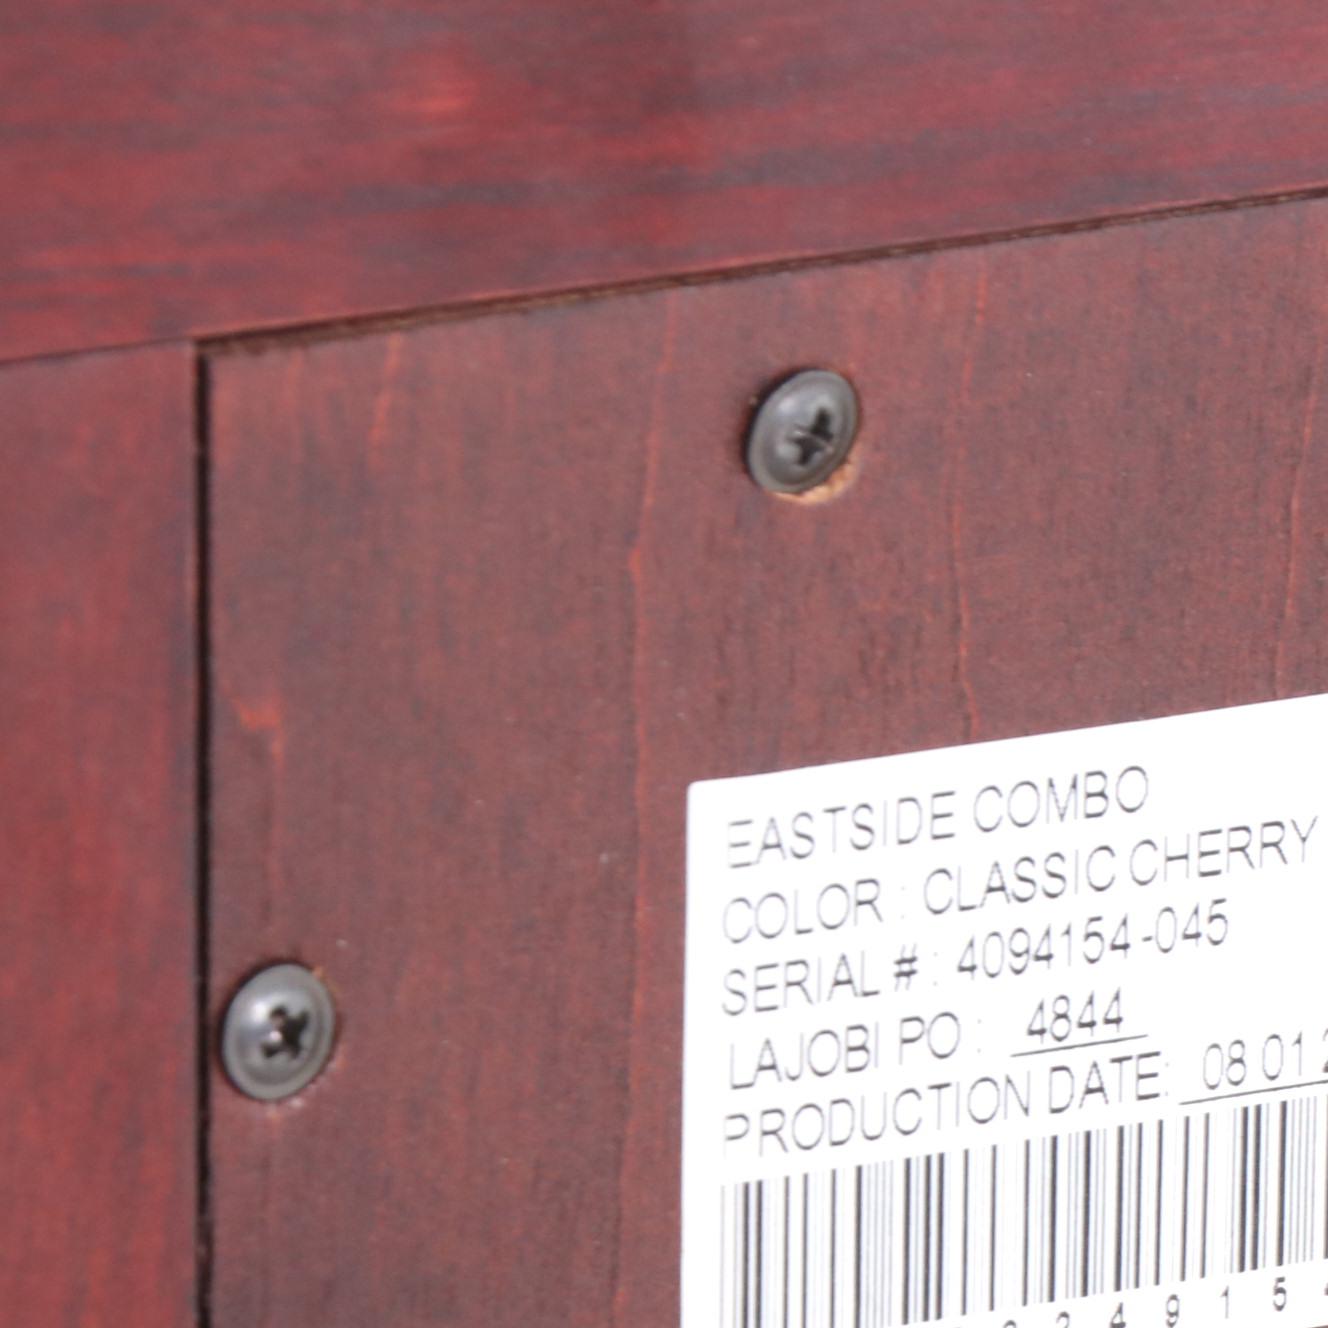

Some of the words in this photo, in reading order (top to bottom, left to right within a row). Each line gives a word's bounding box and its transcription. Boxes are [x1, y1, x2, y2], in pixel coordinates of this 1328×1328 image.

[727, 791, 956, 869] EASTSIDE
[973, 765, 1150, 833] COMBO
[923, 845, 1117, 917] CLASSIC
[1129, 815, 1319, 889] CHERRY
[721, 957, 880, 1017] SERIAL
[956, 898, 1230, 981] 4094154-045
[728, 1021, 880, 1091] LAJOBI
[1025, 987, 1126, 1047] 4844
[722, 1073, 1031, 1159] PRODUCTION
[1047, 1051, 1172, 1114] DATE:
[1202, 1033, 1247, 1091] 08
[1262, 1031, 1303, 1081] 01
